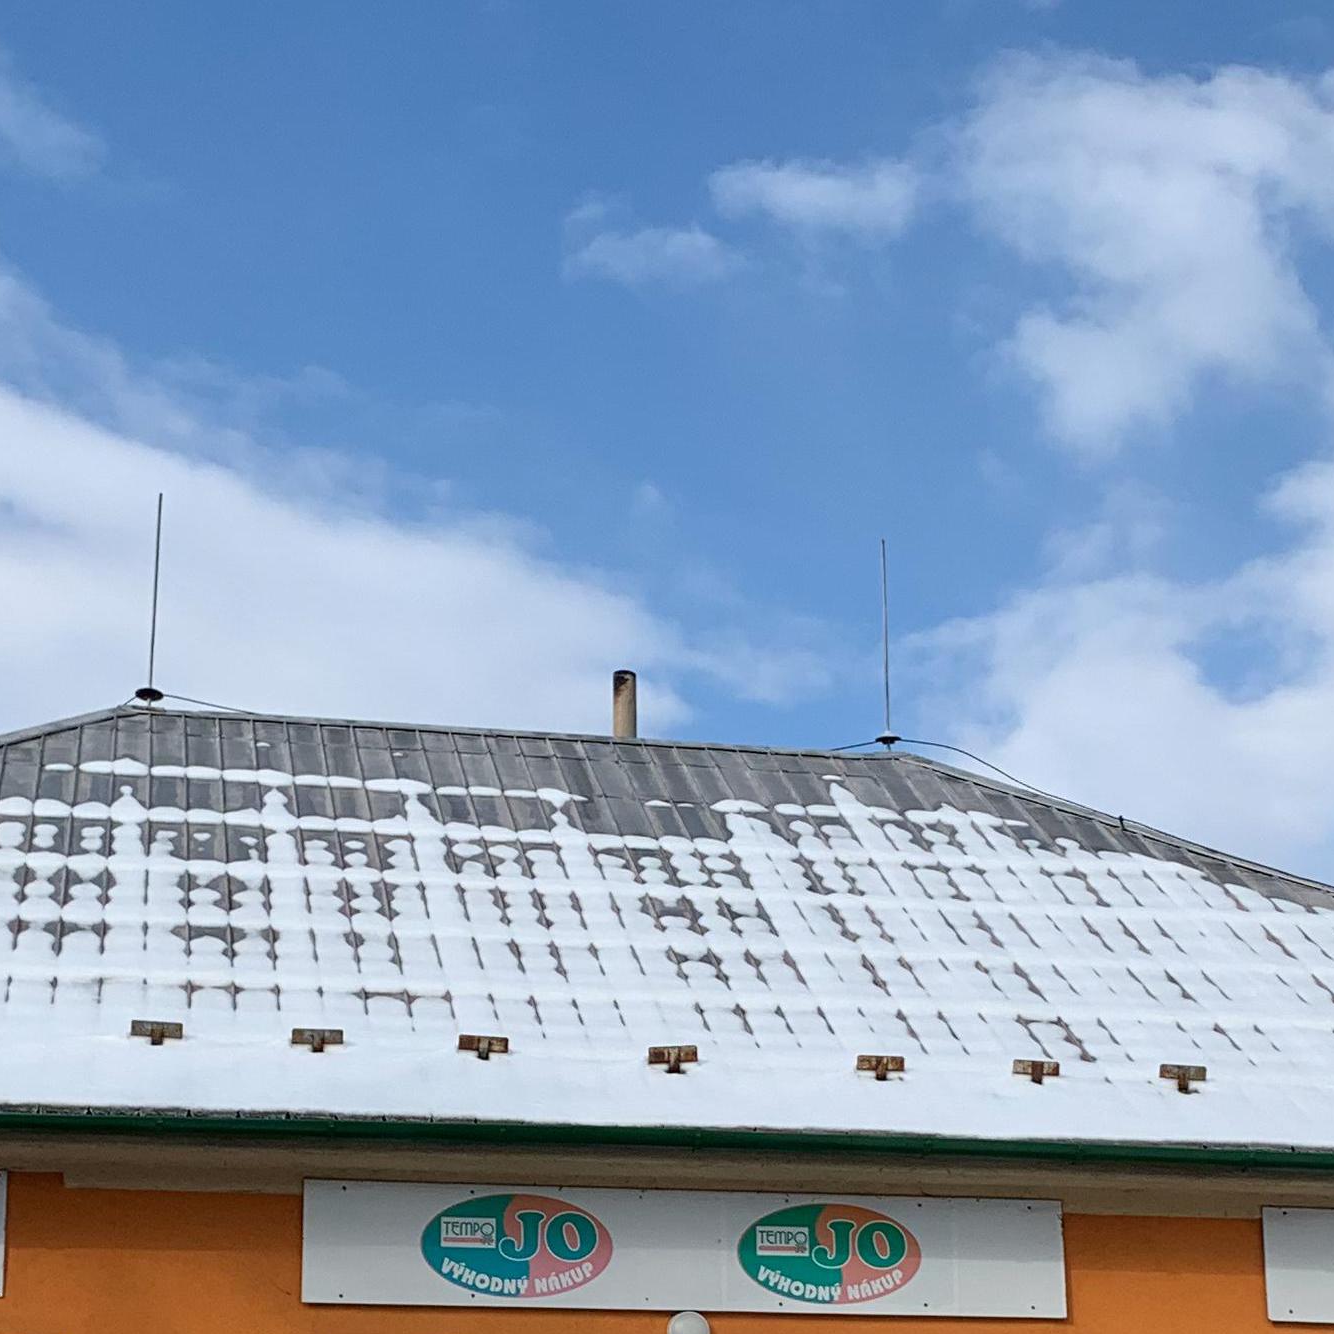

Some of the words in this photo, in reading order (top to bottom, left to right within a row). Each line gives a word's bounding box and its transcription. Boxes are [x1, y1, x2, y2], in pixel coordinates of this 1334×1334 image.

[443, 1221, 495, 1237] TEMPO
[499, 1210, 599, 1262] JO
[758, 1230, 808, 1245] TEMPO
[811, 1219, 908, 1270] JO
[441, 1257, 529, 1295] VÝHODNÝ
[534, 1262, 595, 1294] NÁKUP
[757, 1265, 841, 1301] VÝHODNÝ
[847, 1269, 904, 1300] NÁKUP
